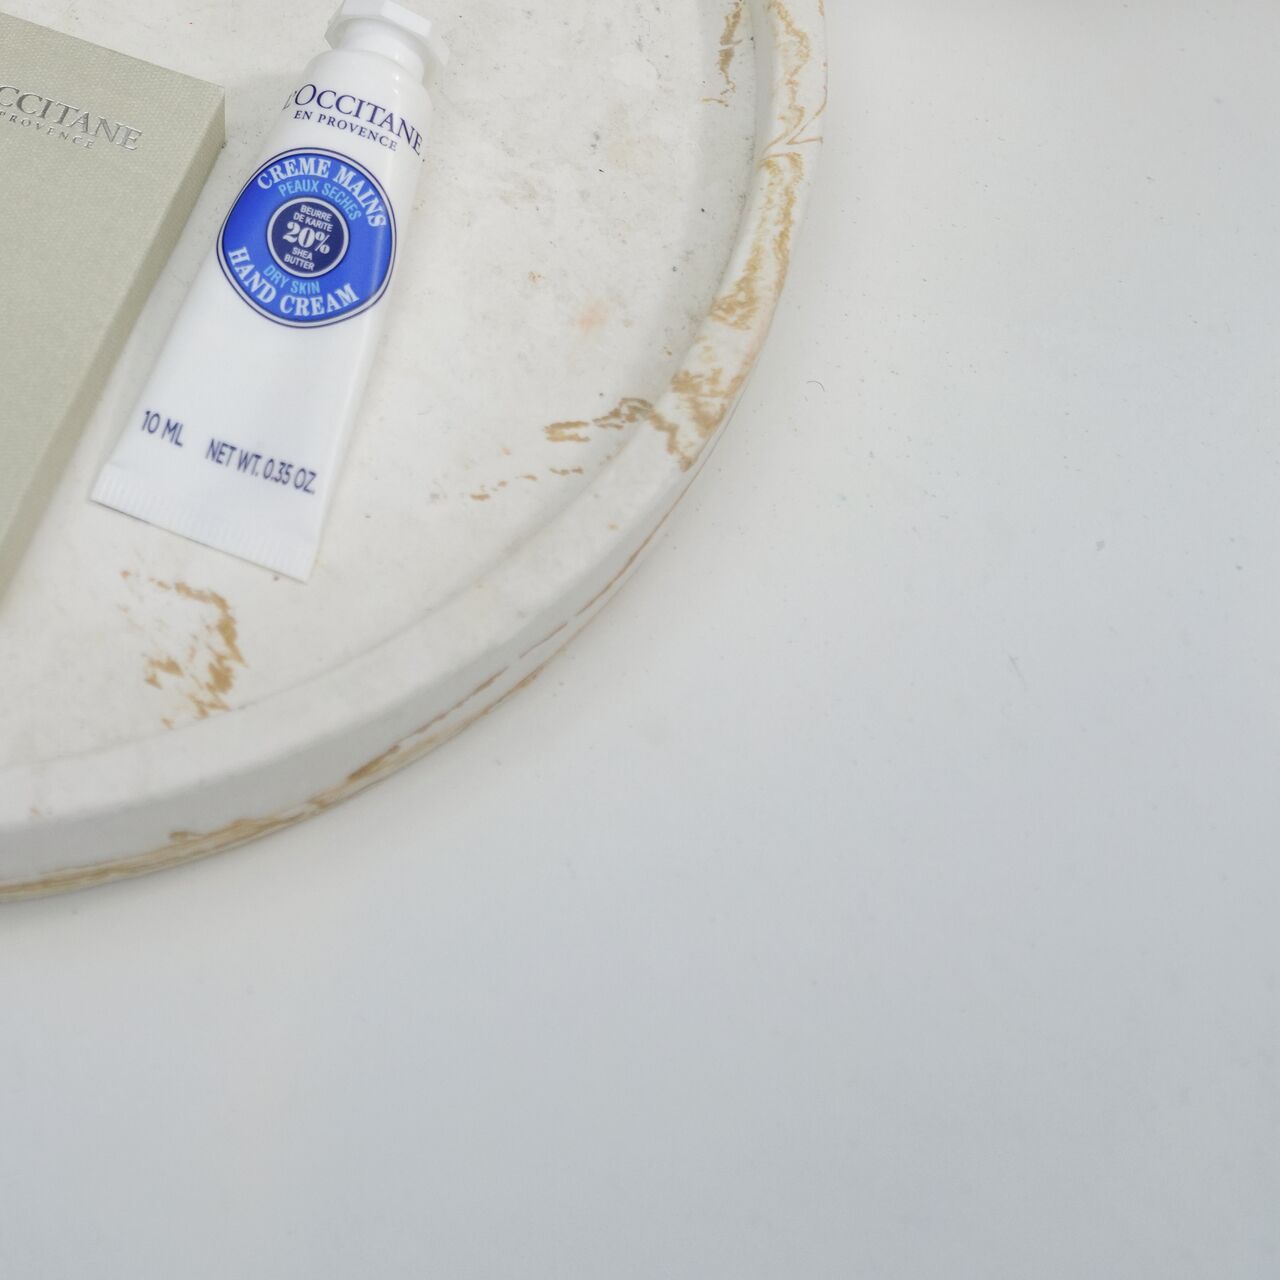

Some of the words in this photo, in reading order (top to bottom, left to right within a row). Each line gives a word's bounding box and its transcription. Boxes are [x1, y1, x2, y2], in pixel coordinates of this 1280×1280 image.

[281, 83, 423, 157] L'OCCITANE
[294, 109, 313, 120] EN
[318, 113, 397, 152] PROVENCE
[257, 157, 332, 190] CREME
[333, 165, 387, 228] MAINS
[278, 179, 319, 198] PEAUX
[321, 182, 362, 221] SECHES
[293, 212, 306, 225] DE
[300, 204, 333, 223] BEURRE
[283, 221, 331, 255] 20%
[292, 247, 313, 261] SHEA
[228, 246, 277, 304] HAND
[280, 283, 360, 317] CREAM
[263, 264, 290, 289] DRY
[290, 279, 321, 294] SKIN
[284, 253, 316, 272] BUTTER
[141, 410, 160, 434] 10
[161, 418, 184, 447] ML
[205, 438, 237, 468] NET
[236, 448, 263, 477] WT.
[263, 458, 294, 485] 0.35
